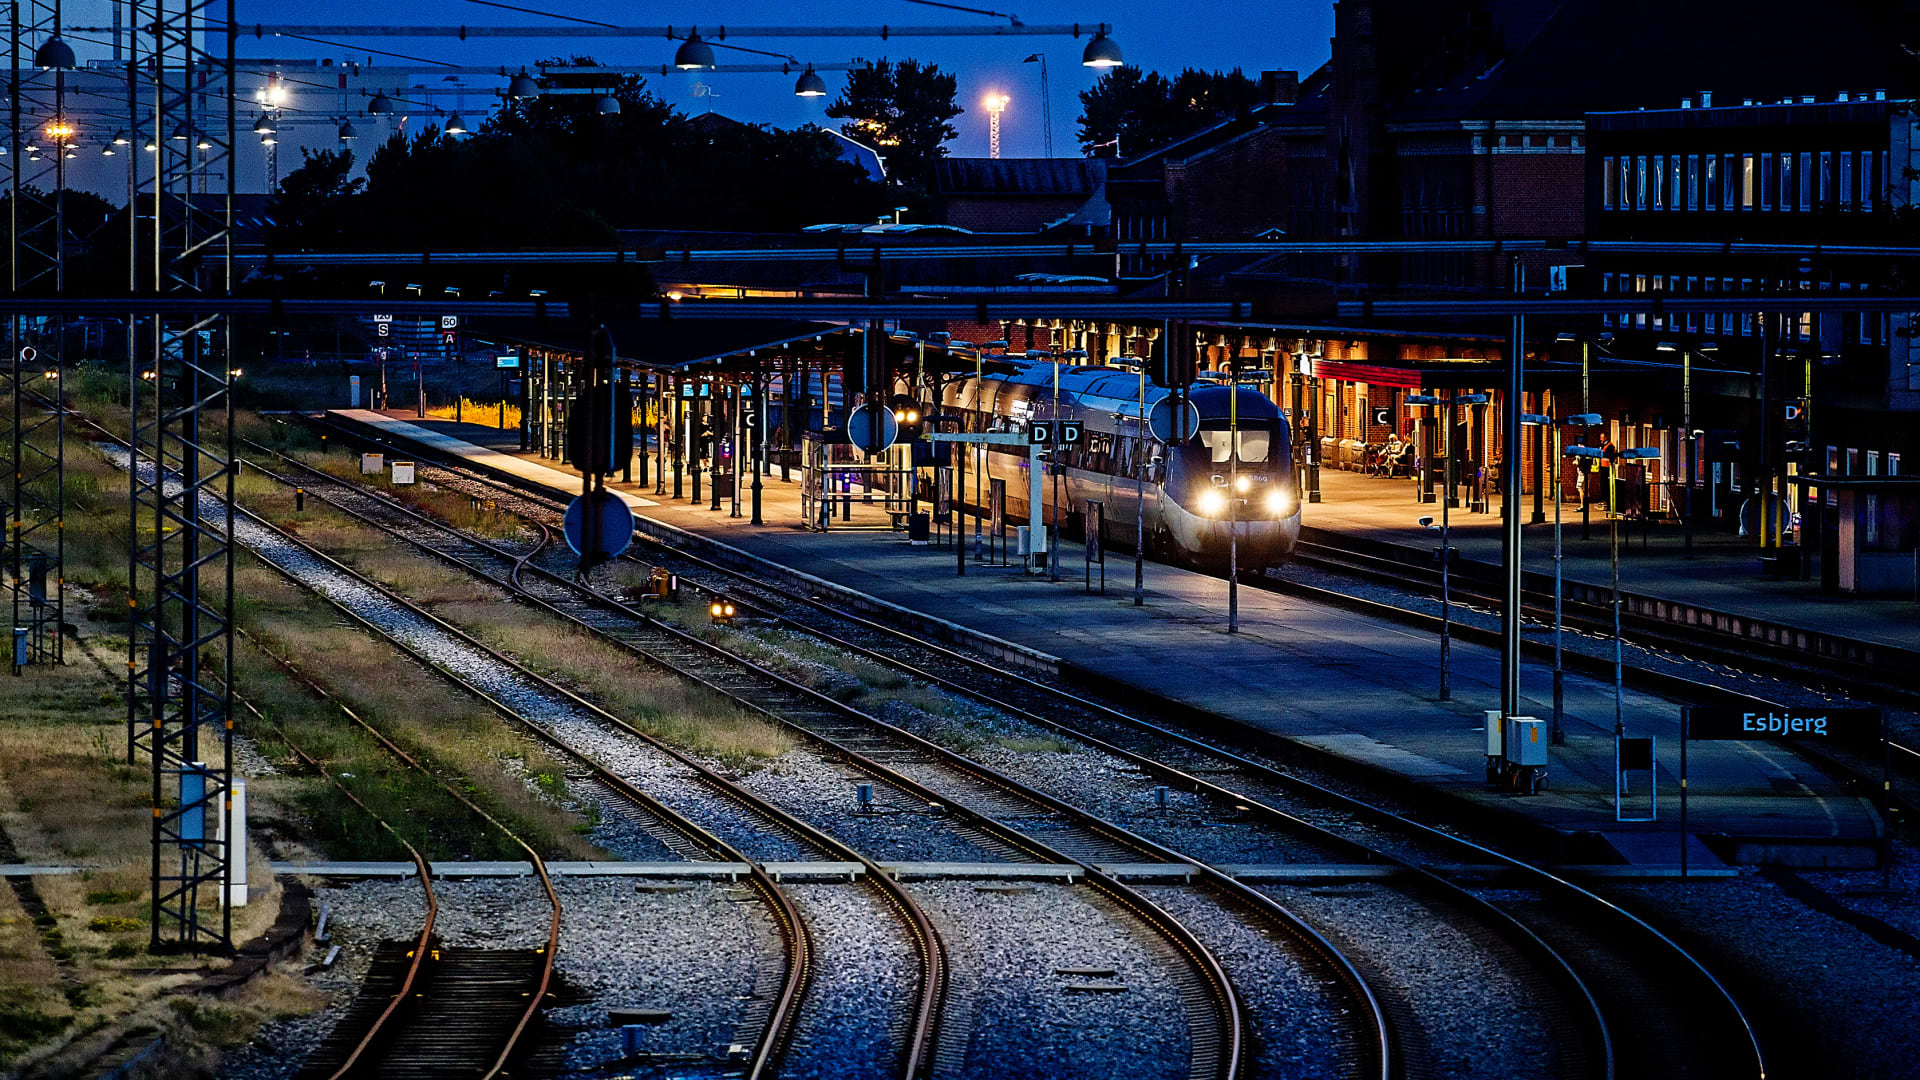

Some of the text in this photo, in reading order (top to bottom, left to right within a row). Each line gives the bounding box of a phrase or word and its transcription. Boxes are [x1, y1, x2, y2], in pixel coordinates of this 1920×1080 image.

[443, 318, 456, 326] 60
[379, 325, 388, 335] S
[445, 334, 454, 343] A
[1377, 411, 1387, 424] C
[1785, 406, 1798, 419] D
[746, 413, 755, 426] C
[1034, 426, 1047, 441] D
[1065, 426, 1078, 441] D
[1743, 712, 1827, 736] Esbjerg
